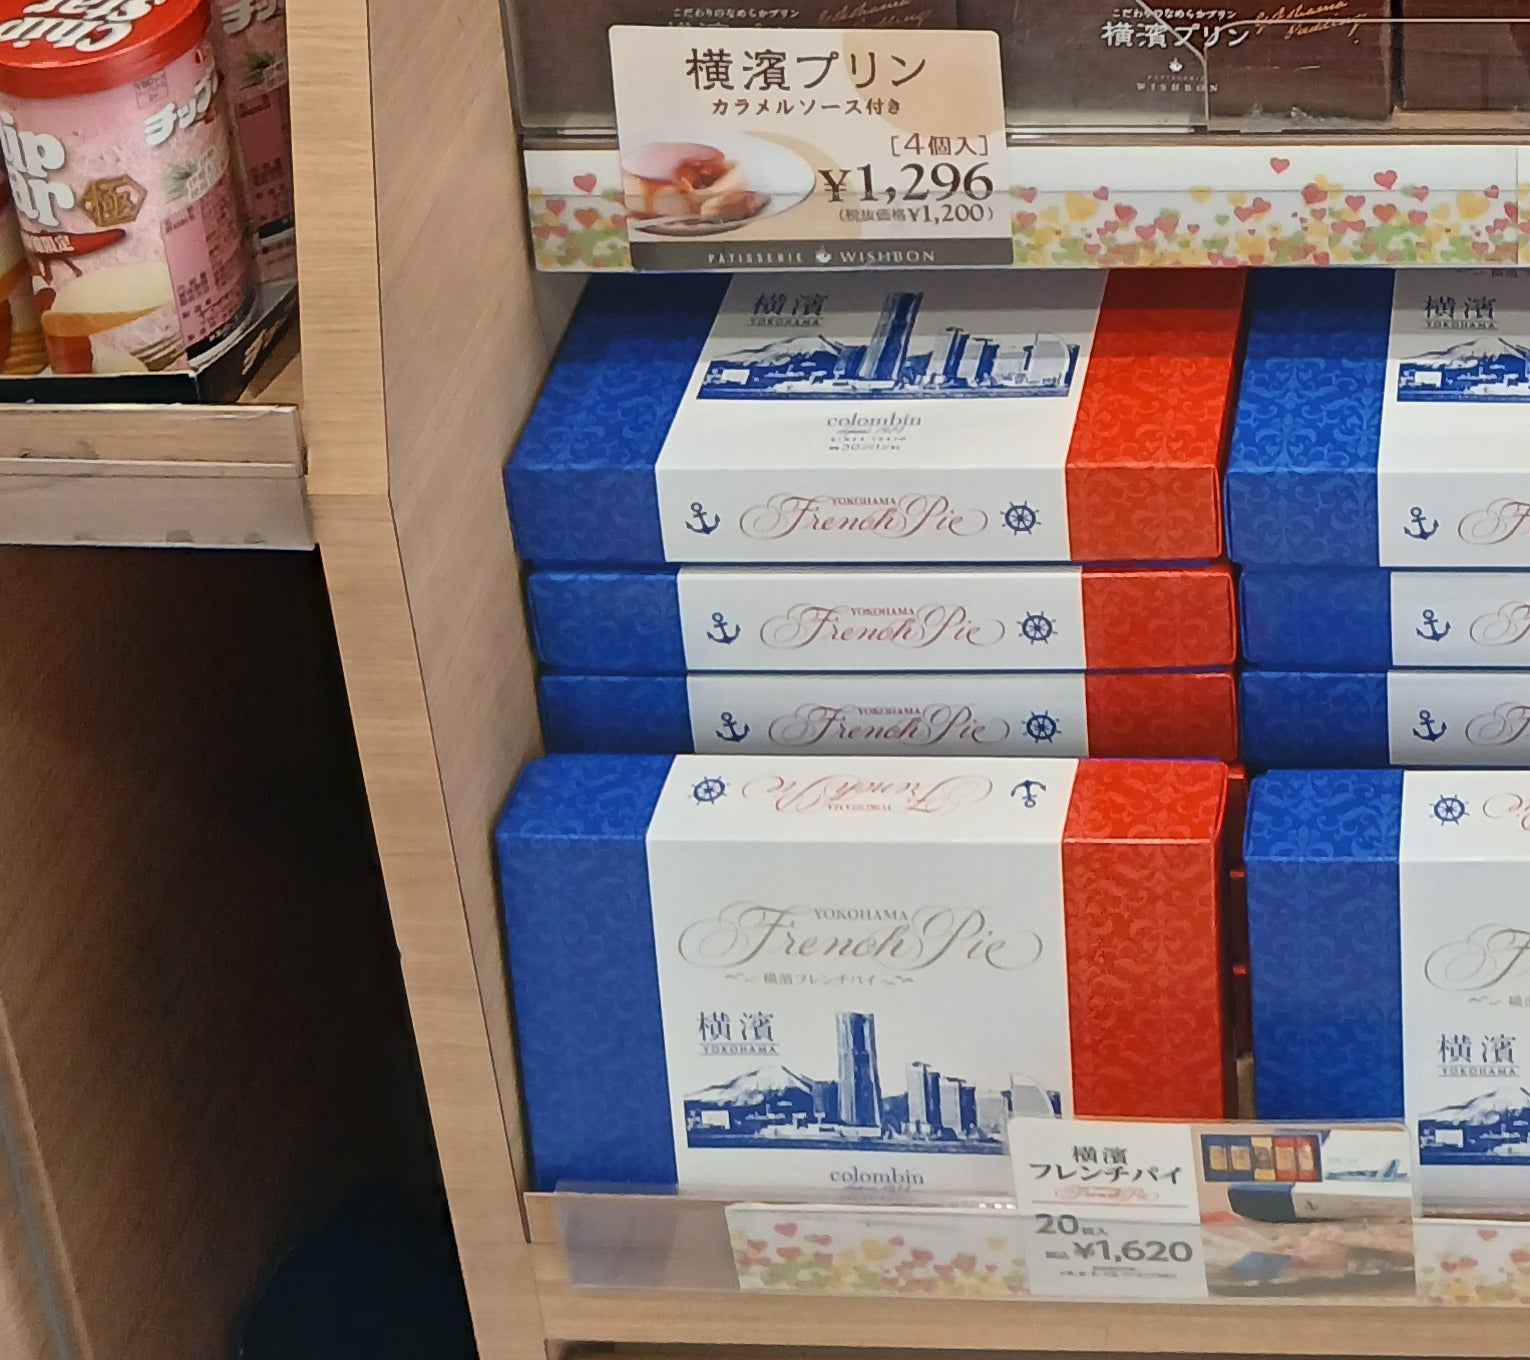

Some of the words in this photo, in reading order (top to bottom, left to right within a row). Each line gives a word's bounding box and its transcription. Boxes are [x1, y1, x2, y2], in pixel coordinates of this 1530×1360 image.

[686, 47, 927, 92] 横濱プリン
[711, 98, 901, 117] カラメルソース付き
[818, 160, 994, 204] ¥1,296
[839, 249, 936, 264] WISHBON
[826, 412, 923, 428] colombin
[829, 496, 897, 507] YOKOHAMA
[739, 492, 908, 539] French
[813, 908, 910, 922] YOKOHAMA
[678, 900, 924, 971] French
[698, 1011, 776, 1043] 横濱
[1437, 1033, 1518, 1065] 横濱
[1072, 1145, 1128, 1165] 横濱
[829, 1167, 925, 1186] colombin
[1028, 1163, 1183, 1185] フレンチパイ
